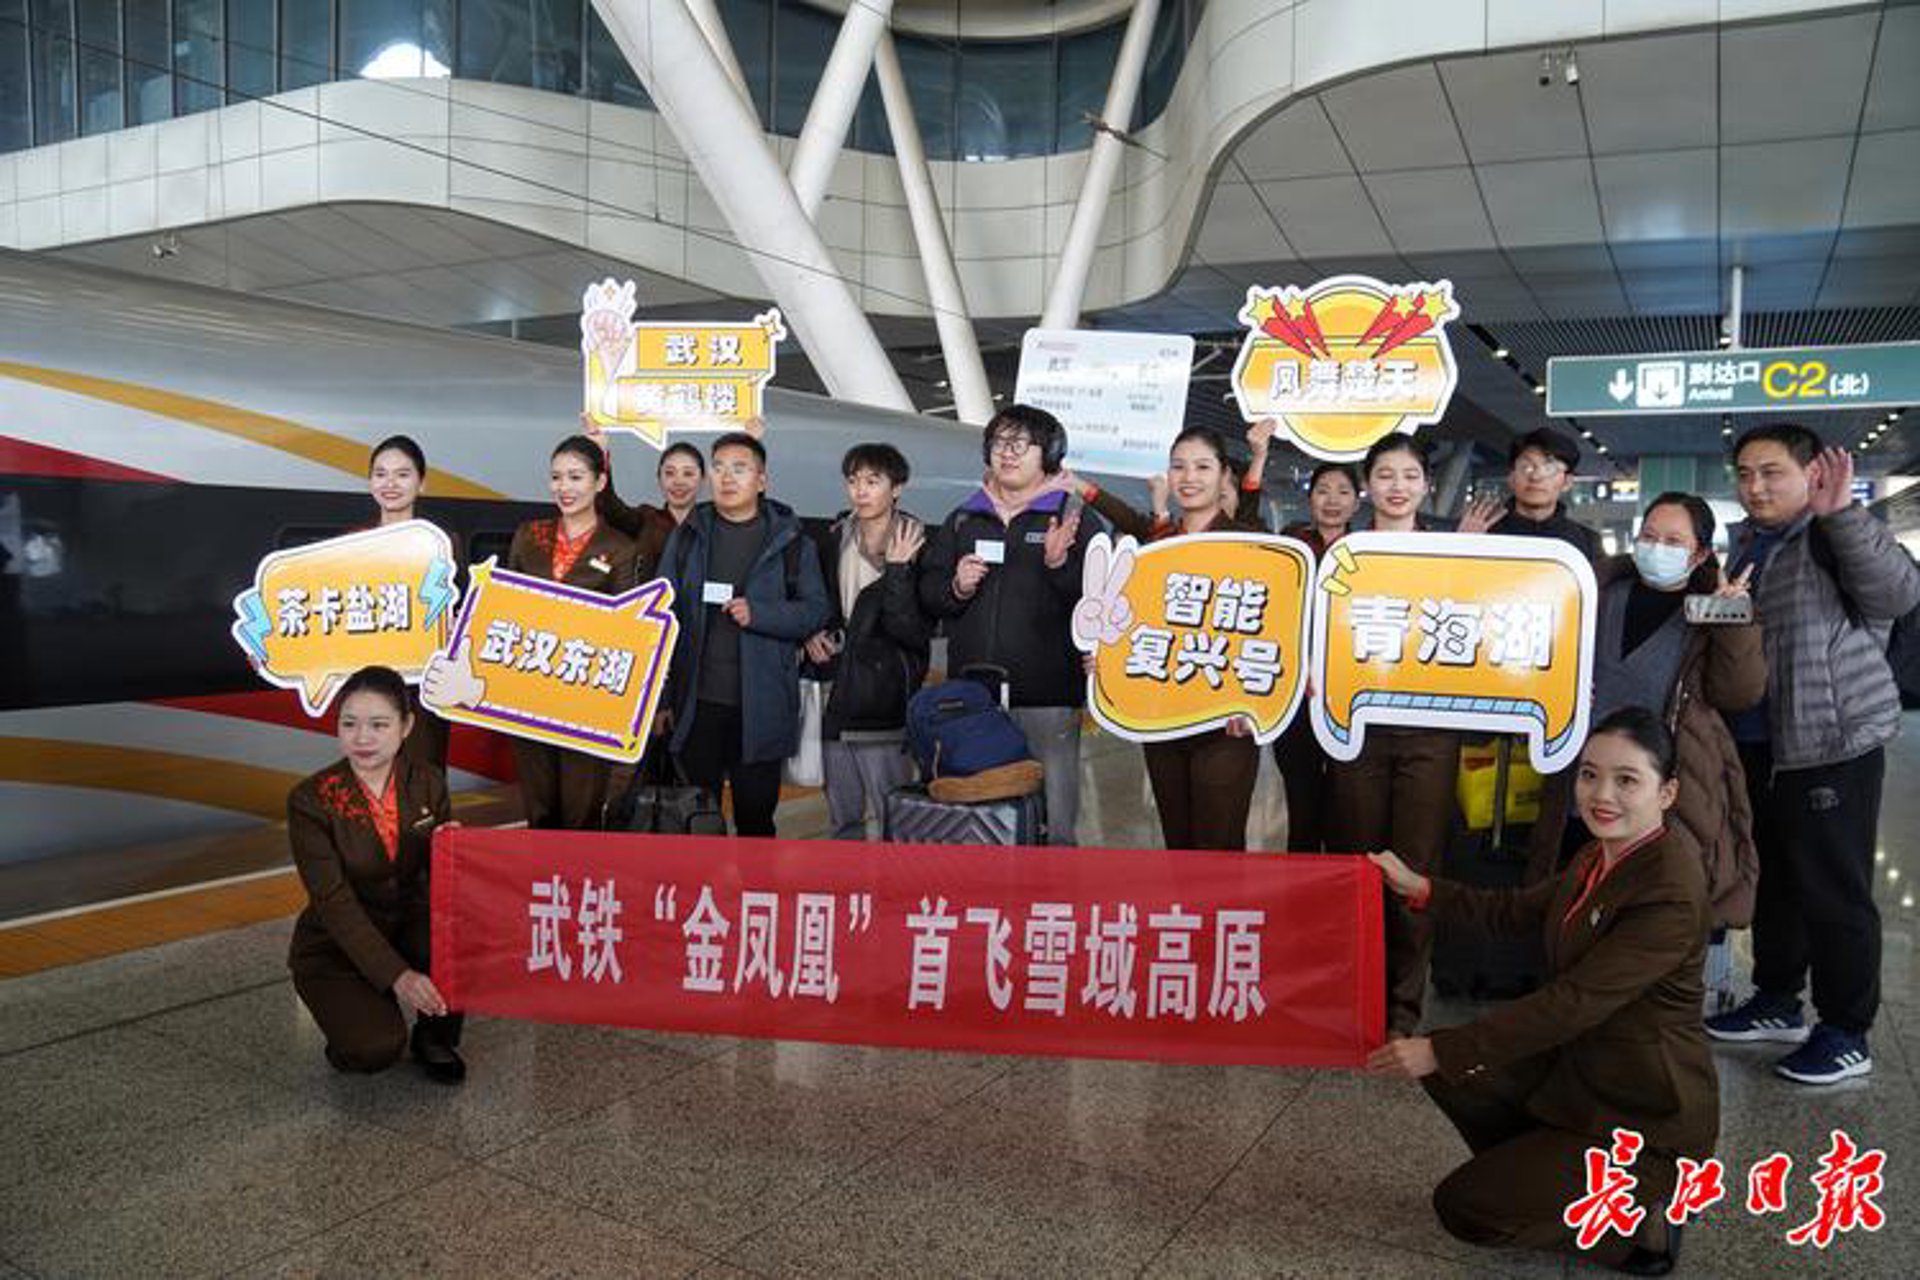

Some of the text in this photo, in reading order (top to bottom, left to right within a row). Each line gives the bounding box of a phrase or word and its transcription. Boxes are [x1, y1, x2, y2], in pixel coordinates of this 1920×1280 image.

[664, 333, 744, 366] 武汉
[1689, 360, 1760, 385] 到达口
[1763, 361, 1827, 398] C2
[277, 583, 413, 637] 茶卡盐湖
[1164, 572, 1269, 634] 智能
[1350, 596, 1559, 669] 青海湖
[479, 617, 637, 697] 武汉东湖
[1123, 624, 1284, 695] 复兴号
